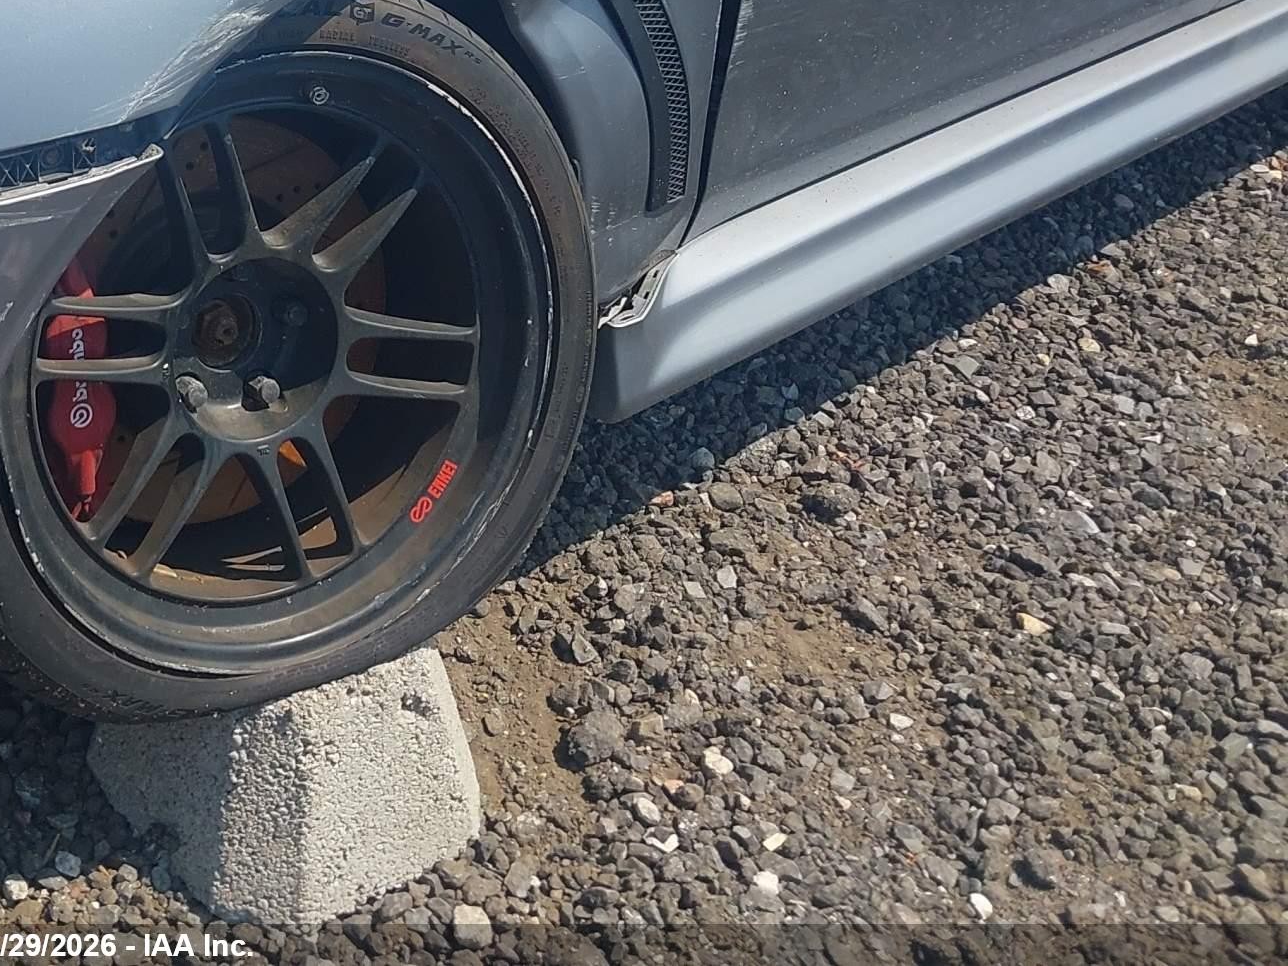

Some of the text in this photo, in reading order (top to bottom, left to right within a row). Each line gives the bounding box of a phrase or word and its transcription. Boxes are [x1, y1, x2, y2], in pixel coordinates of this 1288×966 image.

[352, 5, 373, 20] GT
[68, 327, 89, 403] brbo
[427, 459, 458, 499] ENKEI
